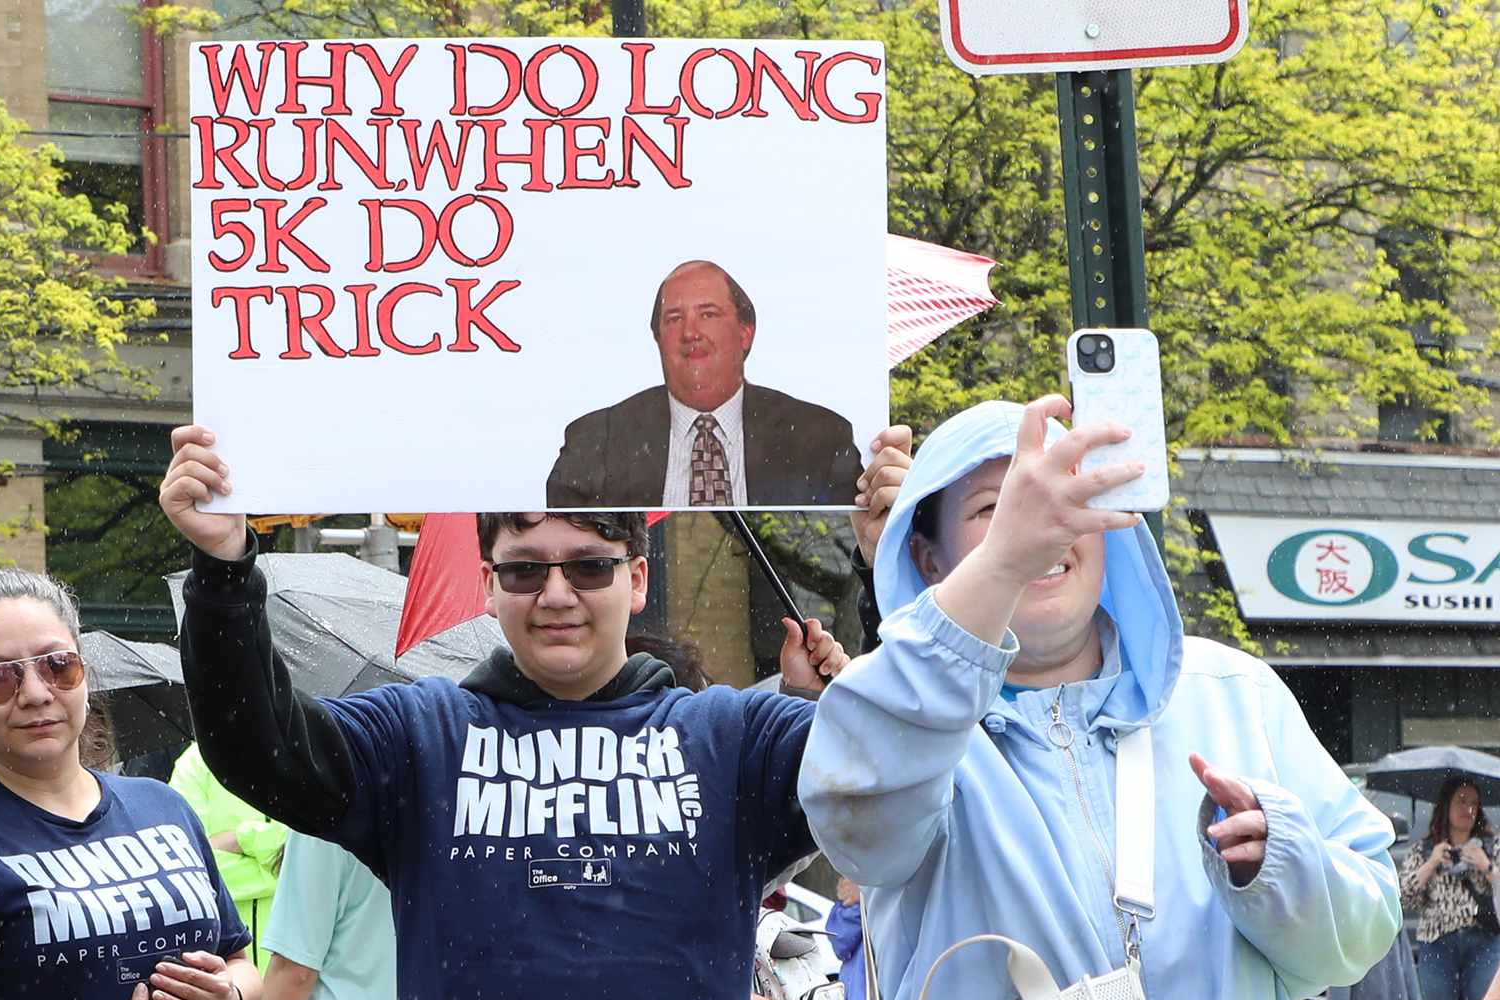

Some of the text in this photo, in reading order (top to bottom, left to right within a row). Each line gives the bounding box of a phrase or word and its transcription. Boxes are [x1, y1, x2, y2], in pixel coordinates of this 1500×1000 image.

[198, 41, 882, 124] WHY DO LONG
[396, 116, 692, 193] WHEN
[207, 194, 514, 274] 5K DO
[211, 278, 522, 360] TRICK
[1315, 540, 1355, 595] 大阪
[1404, 594, 1494, 610] SUSHI
[462, 723, 686, 784] DUNDER
[453, 777, 684, 839] MIFFLIN
[0, 823, 206, 889] DUNDER
[450, 842, 701, 862] PAPER COMPANY
[532, 875, 558, 884] Office
[26, 869, 220, 946] MIFFLIN
[37, 930, 220, 968] PAPER COMPA
[120, 971, 141, 981] Office
